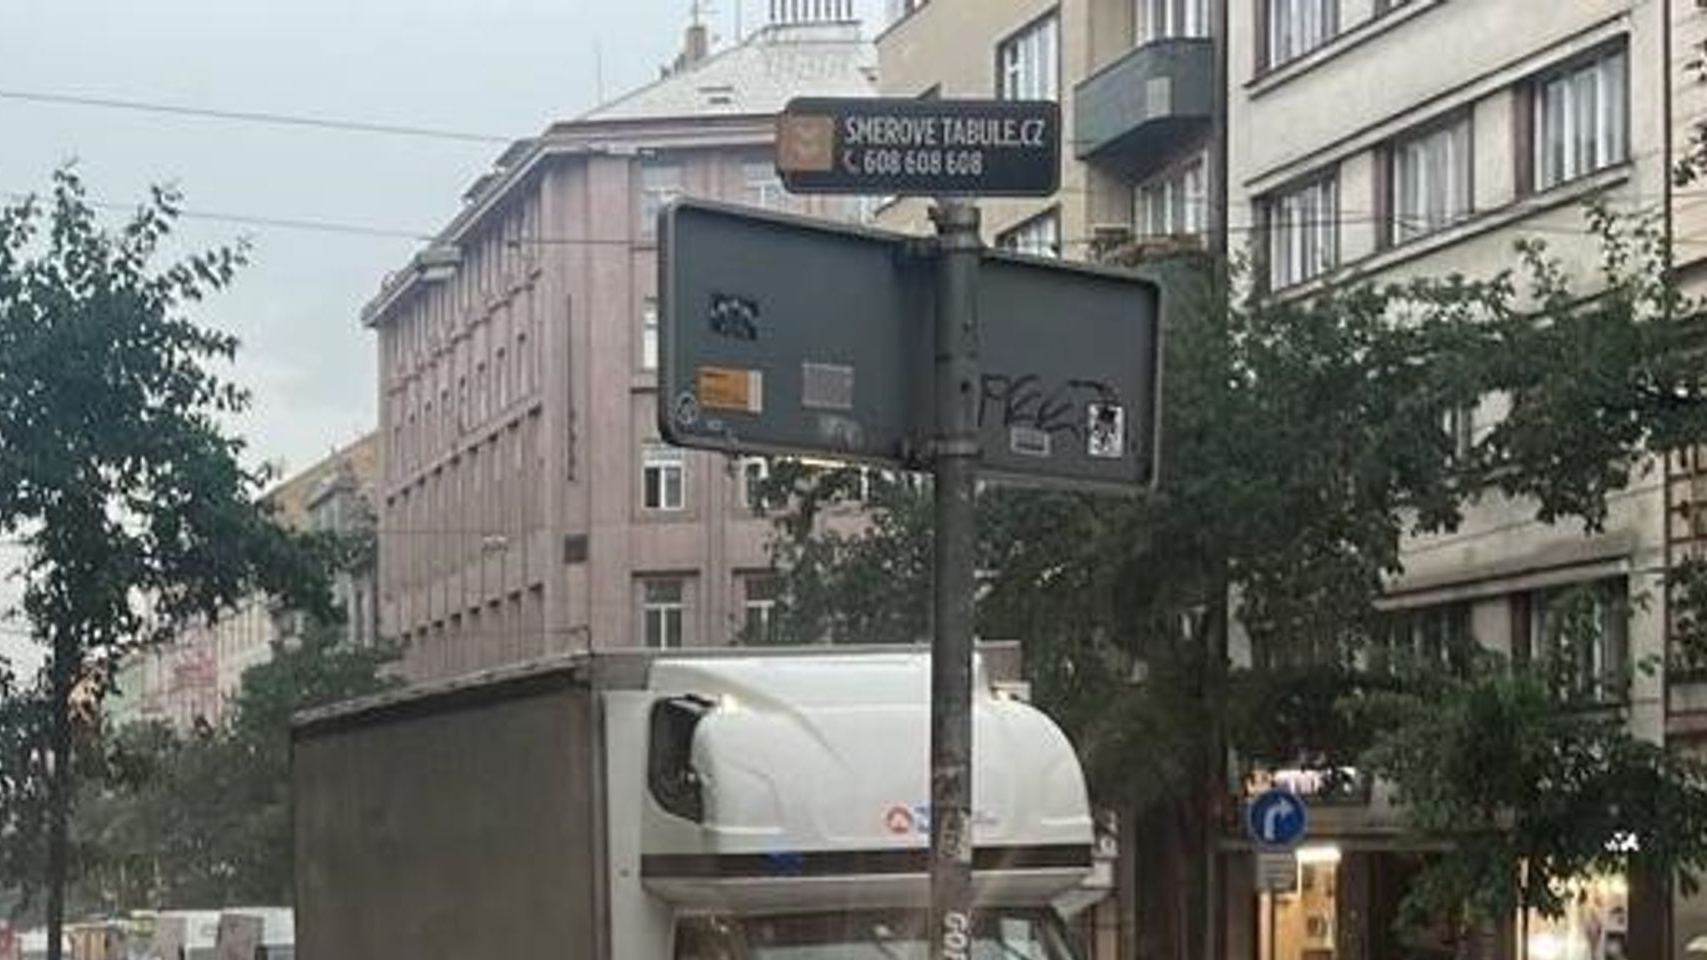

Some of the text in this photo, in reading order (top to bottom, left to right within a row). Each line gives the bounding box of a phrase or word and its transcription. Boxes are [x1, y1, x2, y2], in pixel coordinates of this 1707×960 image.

[863, 149, 983, 176] 608 608 608
